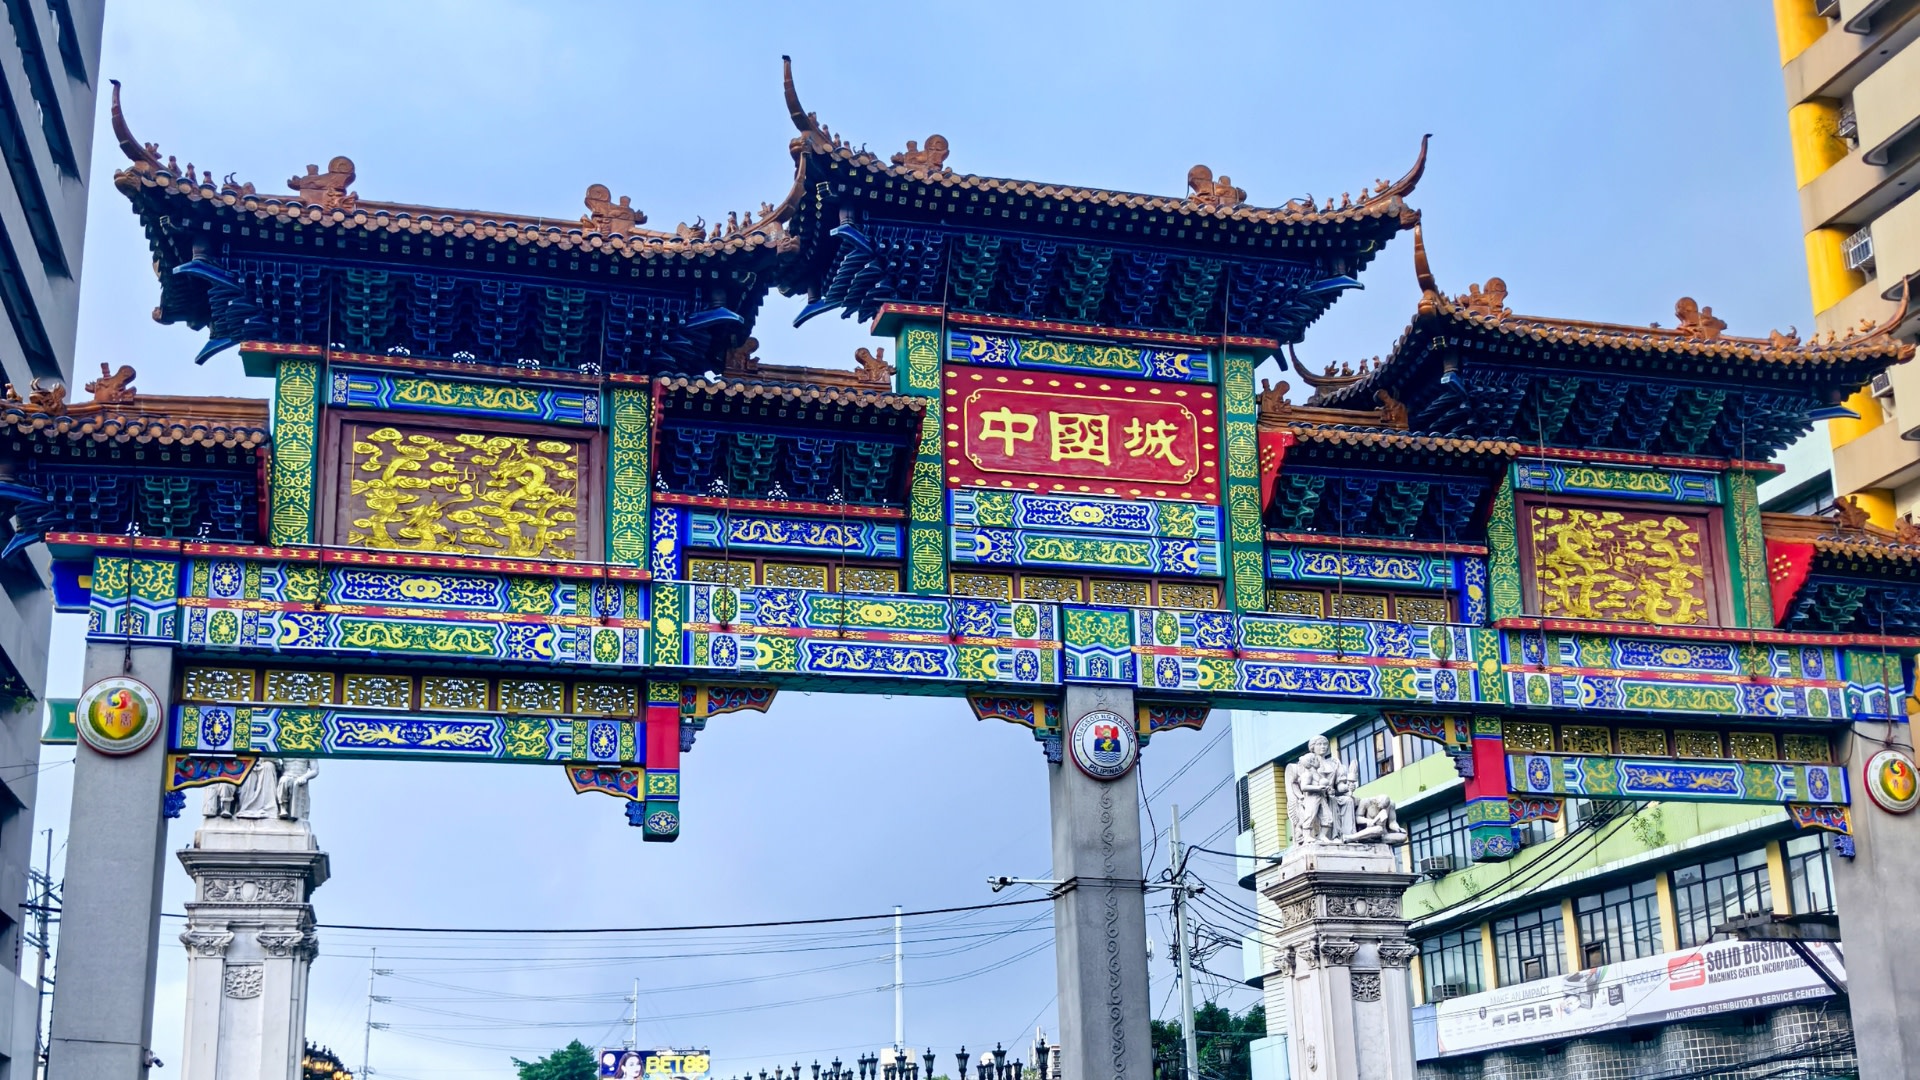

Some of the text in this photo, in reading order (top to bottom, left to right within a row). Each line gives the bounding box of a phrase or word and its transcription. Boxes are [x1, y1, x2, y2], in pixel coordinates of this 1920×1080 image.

[978, 406, 1186, 466] 中國城
[1076, 714, 1100, 742] LUNGSOD
[1089, 763, 1124, 774] PILIPINAS
[1706, 942, 1798, 972] SOLID BUSINE
[1626, 969, 1662, 987] brother
[1708, 968, 1738, 985] MACHINES
[1523, 985, 1550, 1000] IMPACT
[1666, 1006, 1706, 1020] AUTHORIZED
[1708, 998, 1753, 1013] DISTRIBUTOR
[1762, 992, 1793, 1005] SERVICE
[1795, 987, 1826, 999] CENTER
[645, 1054, 709, 1074] BET88
